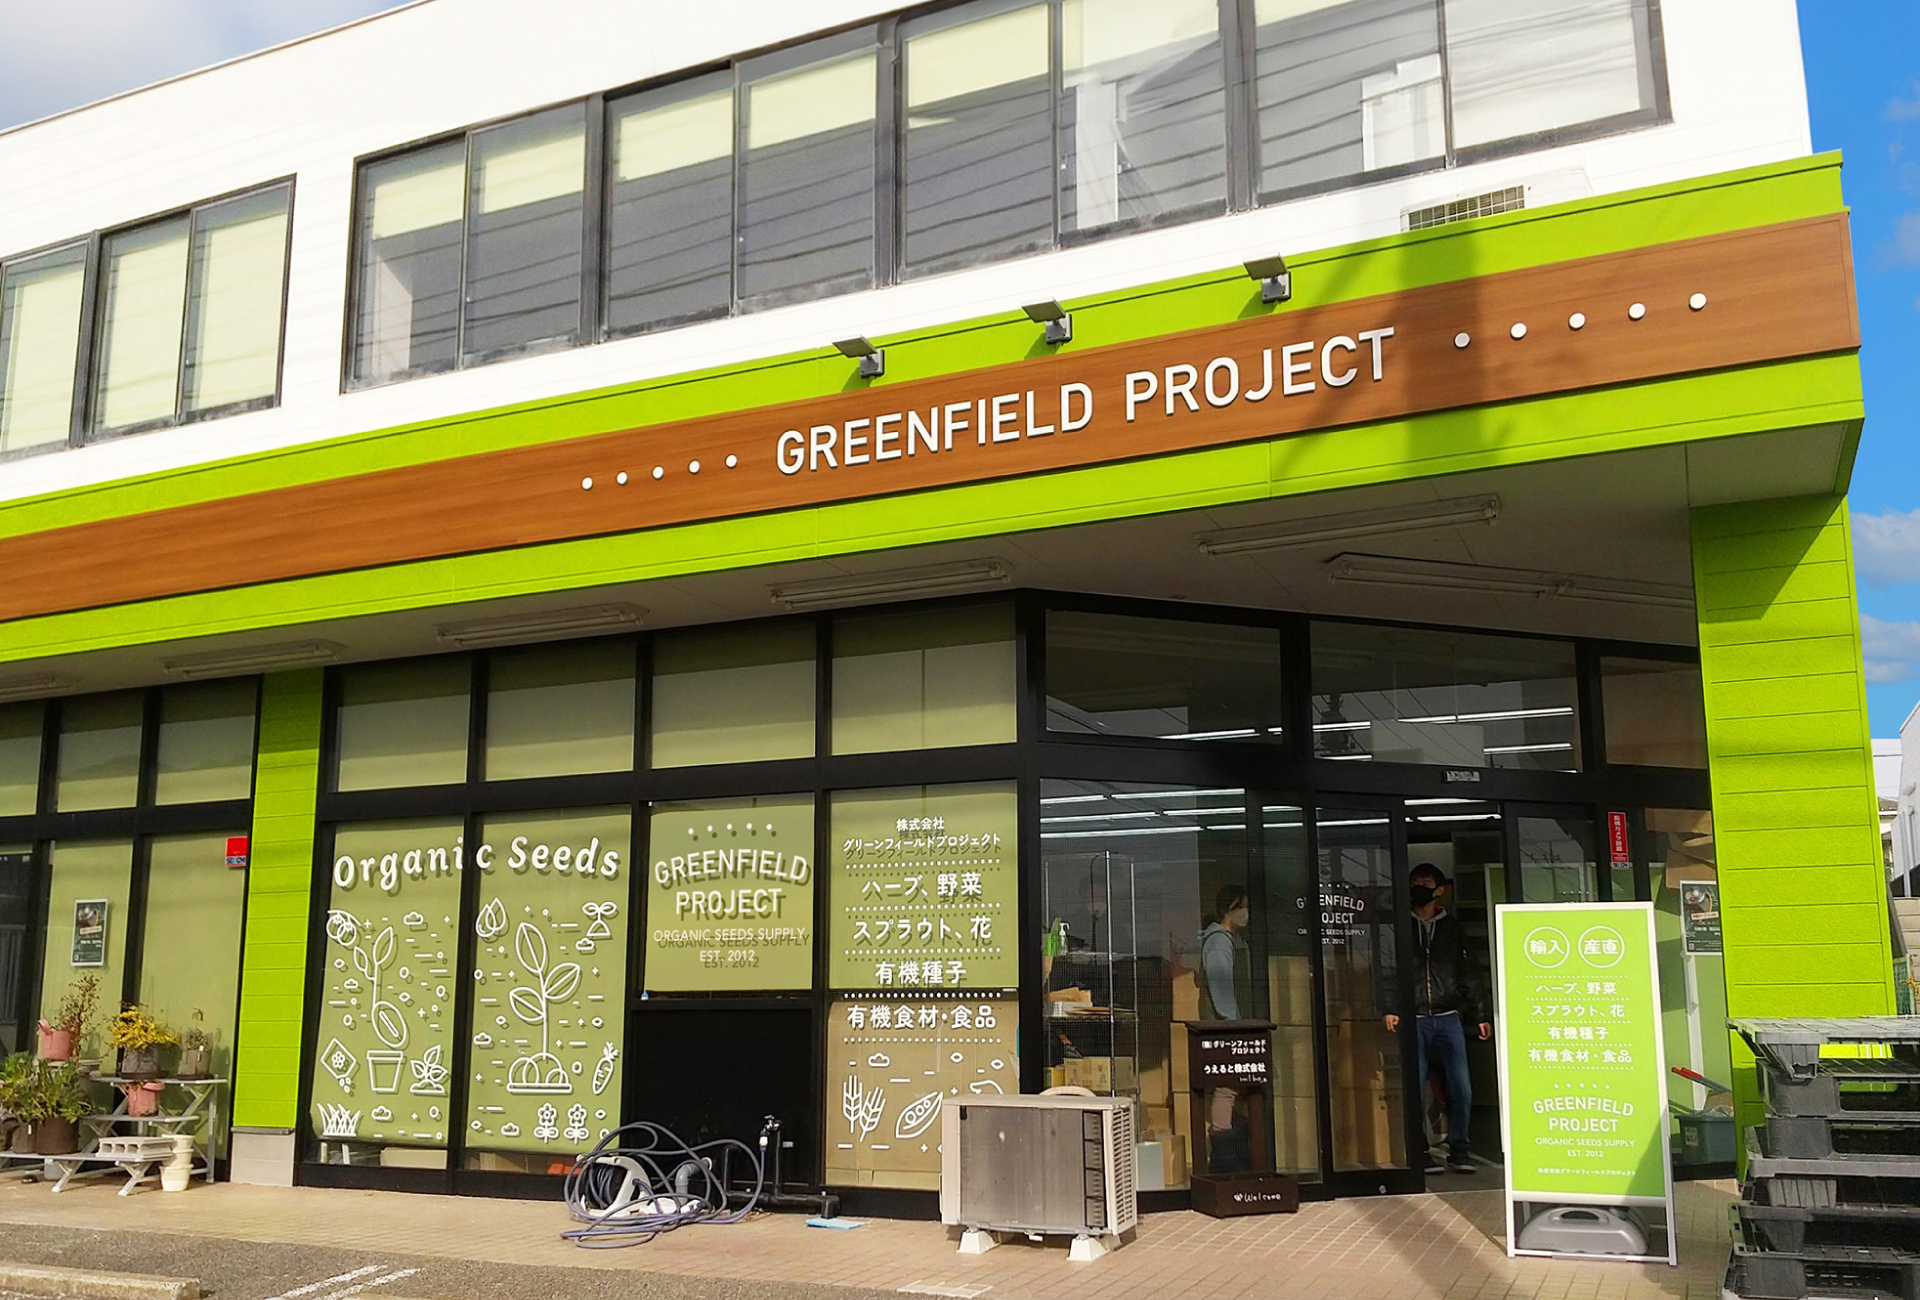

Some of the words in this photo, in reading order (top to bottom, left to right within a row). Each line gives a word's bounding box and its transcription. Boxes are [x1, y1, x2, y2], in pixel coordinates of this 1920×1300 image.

[776, 381, 1094, 475] GREENFIELD
[1125, 327, 1394, 421] PROJECT
[896, 816, 945, 831] 株式会社
[843, 833, 1001, 852] グリーンフィールドプロジェクト
[333, 836, 493, 891] Organic
[507, 836, 619, 876] Seeds
[654, 849, 807, 883] GREENFIELD
[861, 872, 982, 896] ハーブ、野菜
[676, 888, 782, 914] PROJECT
[1296, 894, 1365, 911] GENFIELD
[1321, 912, 1355, 924] OJECT
[653, 928, 711, 942] ORGANIC
[714, 928, 754, 941] SEEDS
[757, 927, 806, 940] SUPPLY
[853, 915, 992, 940] スプラウト、花
[1529, 939, 1565, 955] 輸入
[1584, 938, 1619, 955] 産直
[699, 950, 724, 962] EST.
[727, 949, 755, 962] 2012
[875, 961, 967, 985] 有機種子
[1535, 982, 1618, 995] ハーブ、野菜
[847, 1004, 997, 1029] 有機食材・食品
[1547, 1026, 1610, 1040] 有機種子
[1528, 1048, 1632, 1063] 有機食材・食品
[1203, 1062, 1266, 1075] うえると株式会社
[1533, 1096, 1634, 1117] GREENFIELD
[1549, 1117, 1619, 1132] PROJECT
[1535, 1137, 1574, 1146] ORGANIC
[1576, 1138, 1603, 1147] SEEDS
[1604, 1139, 1636, 1148] SUPPLY
[1567, 1150, 1584, 1158] EST.
[1585, 1150, 1604, 1158] 2012
